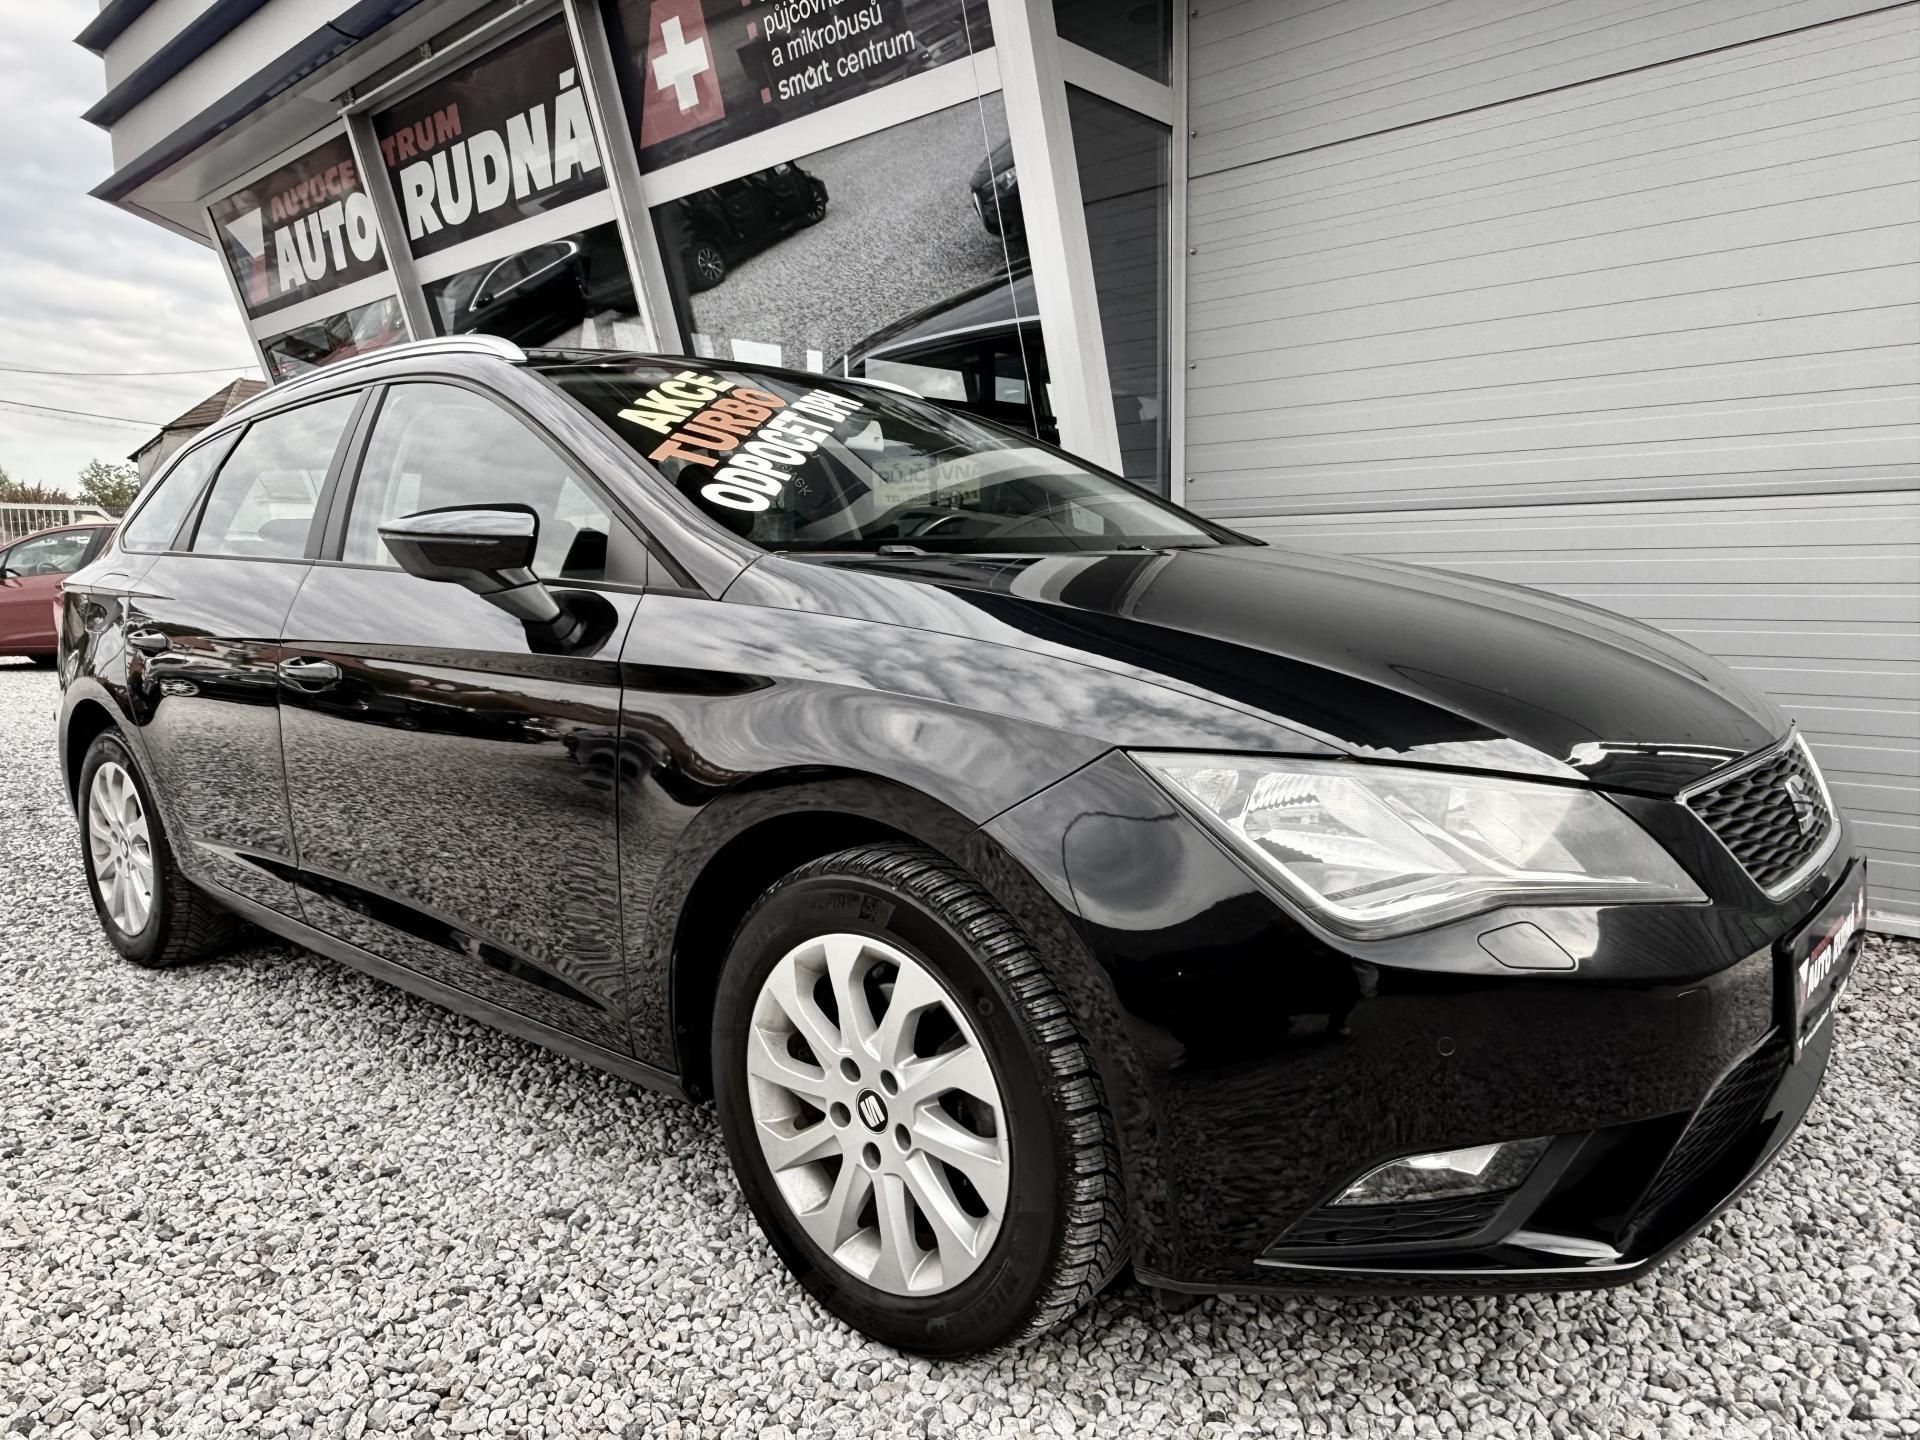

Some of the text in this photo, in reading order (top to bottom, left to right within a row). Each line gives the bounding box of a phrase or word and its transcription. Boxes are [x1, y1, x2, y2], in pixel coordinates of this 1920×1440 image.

[771, 0, 883, 67] a mikrobusů
[778, 30, 916, 100] smart centrum
[274, 67, 602, 292] AUTO RUDNÁ
[617, 370, 736, 435] AKCE
[648, 388, 787, 467] TURBO
[790, 388, 864, 423] DPH
[1807, 944, 1832, 998] AUTO
